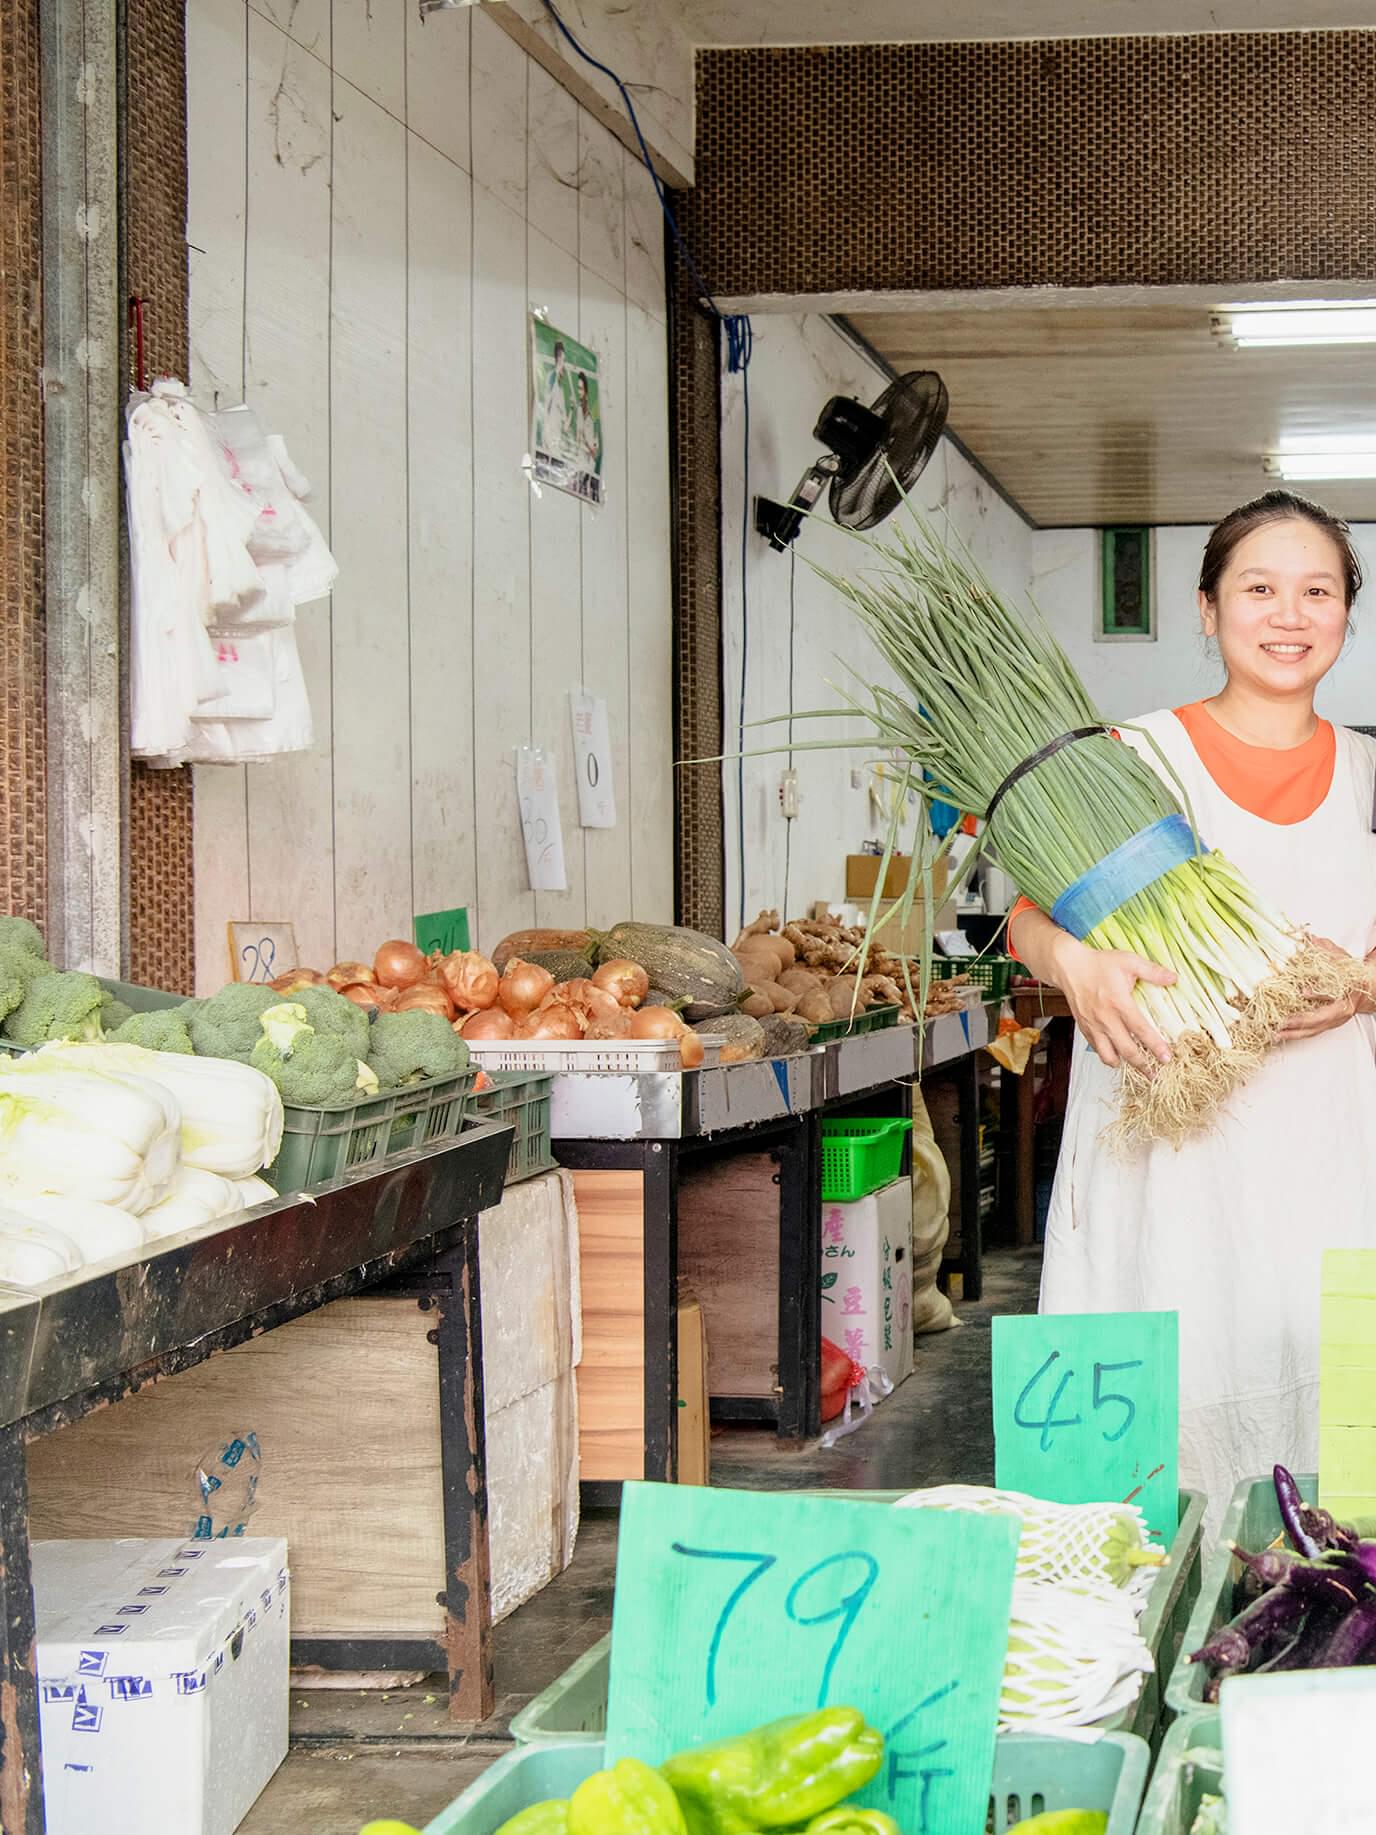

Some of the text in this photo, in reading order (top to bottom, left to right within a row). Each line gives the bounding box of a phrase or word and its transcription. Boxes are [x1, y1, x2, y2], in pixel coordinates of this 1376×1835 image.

[821, 1243, 856, 1259] さん
[1013, 1350, 1144, 1453] 45
[671, 1541, 880, 1708] 79
